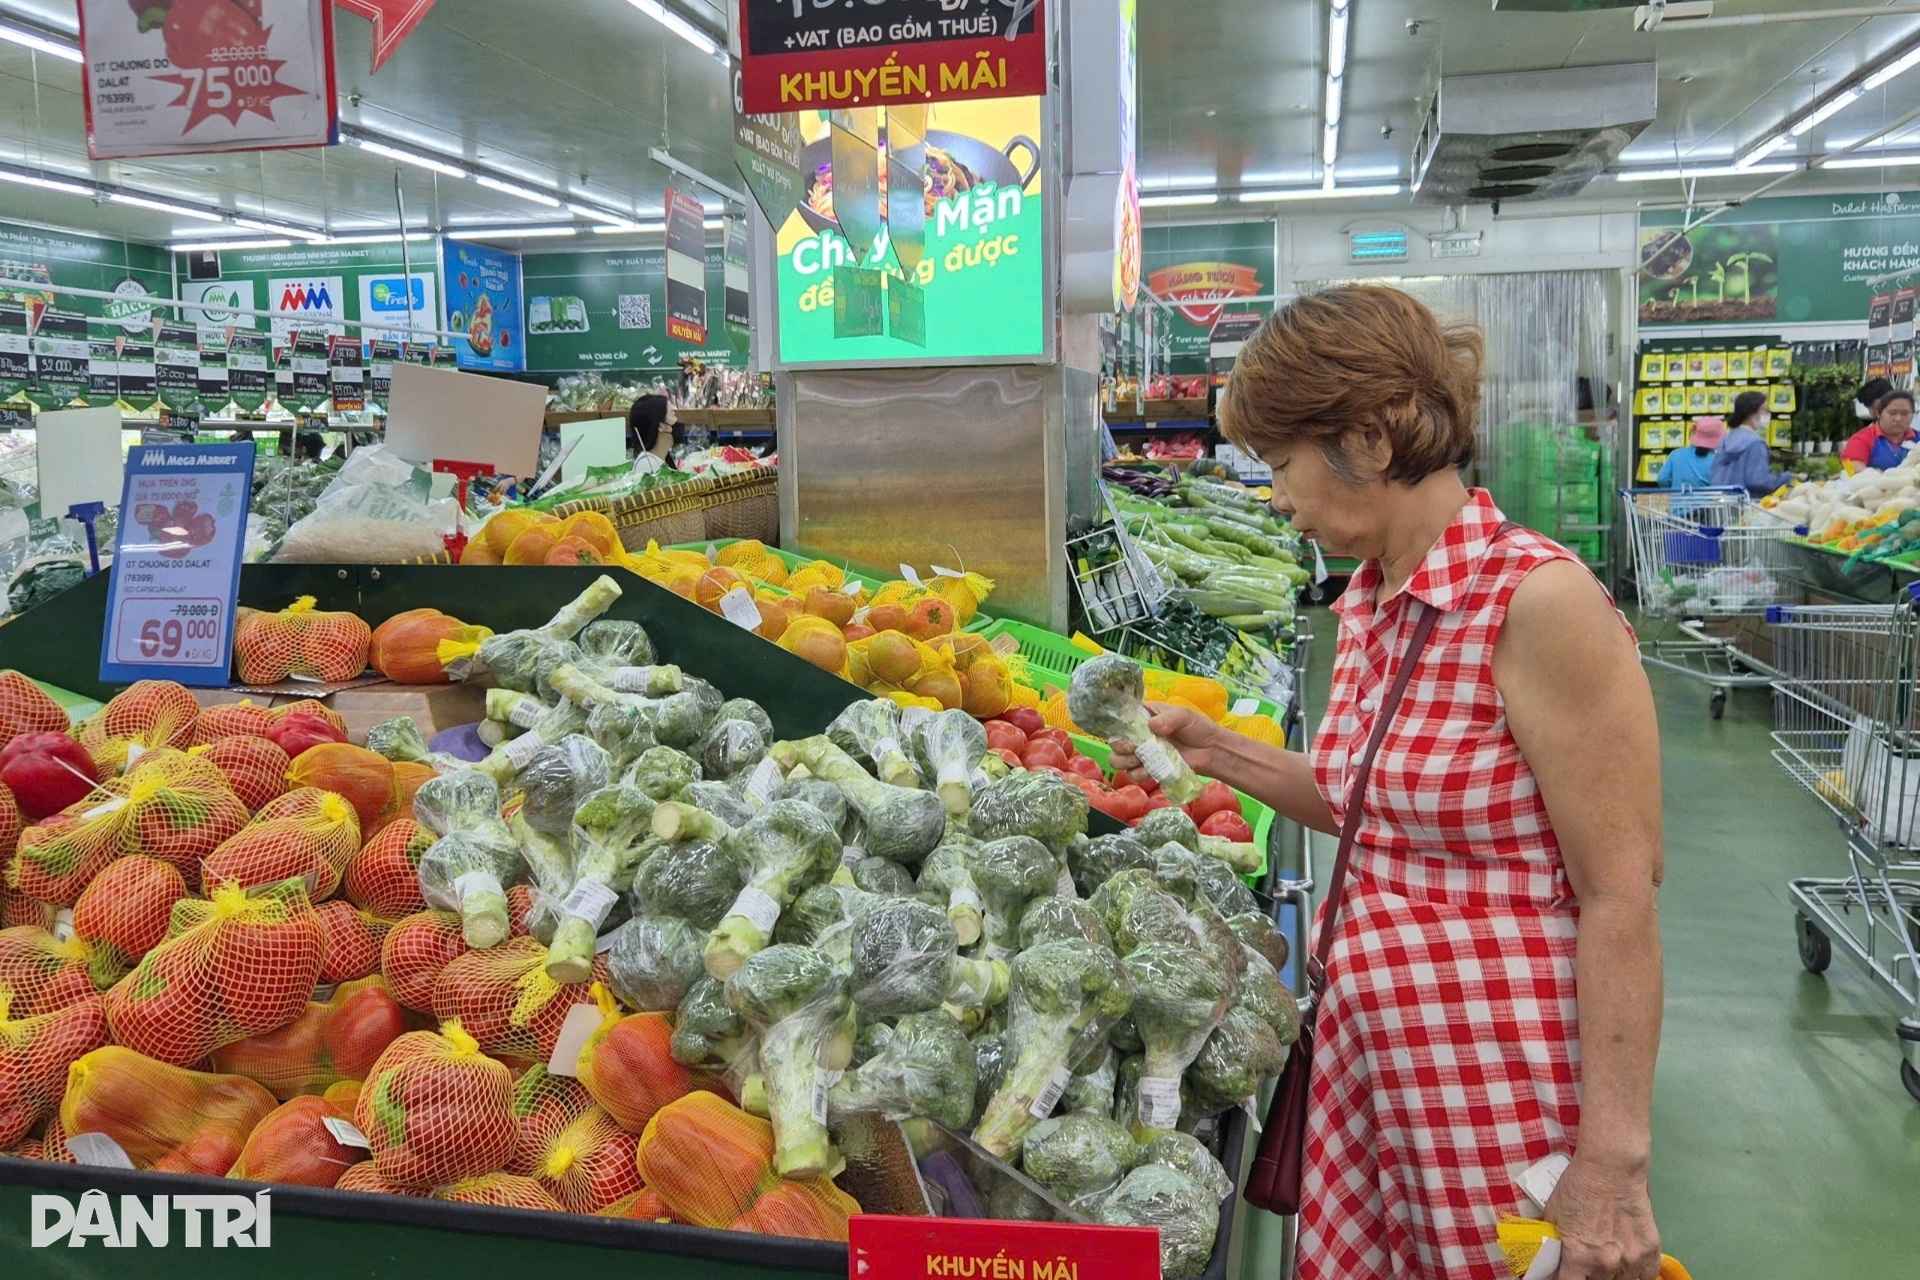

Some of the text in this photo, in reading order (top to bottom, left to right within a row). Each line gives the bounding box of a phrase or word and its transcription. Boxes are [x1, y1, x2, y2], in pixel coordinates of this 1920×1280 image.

[784, 8, 998, 48] +VAT (BAO GỒM THUẾ)
[109, 59, 151, 72] CHUONG
[153, 58, 169, 69] DO
[98, 77, 130, 88] DALAT
[780, 51, 927, 102] KHUYẾN
[939, 50, 1007, 92] MÃI
[181, 65, 272, 110] 75 000
[97, 91, 135, 105] (76399)
[936, 186, 1021, 236] Mặn
[1832, 200, 1866, 215] Dalat
[944, 234, 1019, 272] được
[1844, 241, 1918, 257] HƯỚNG ĐẾN
[1843, 257, 1886, 271] KHÁCH
[613, 350, 628, 360] CẤP
[138, 479, 156, 488] MUA
[138, 560, 170, 568] CHUONG
[171, 560, 183, 568] DO
[185, 559, 212, 568] DALAT
[124, 574, 154, 583] (76399)
[140, 619, 217, 658] 69 000
[926, 1248, 1078, 1280] KHUYẾN MÃI
